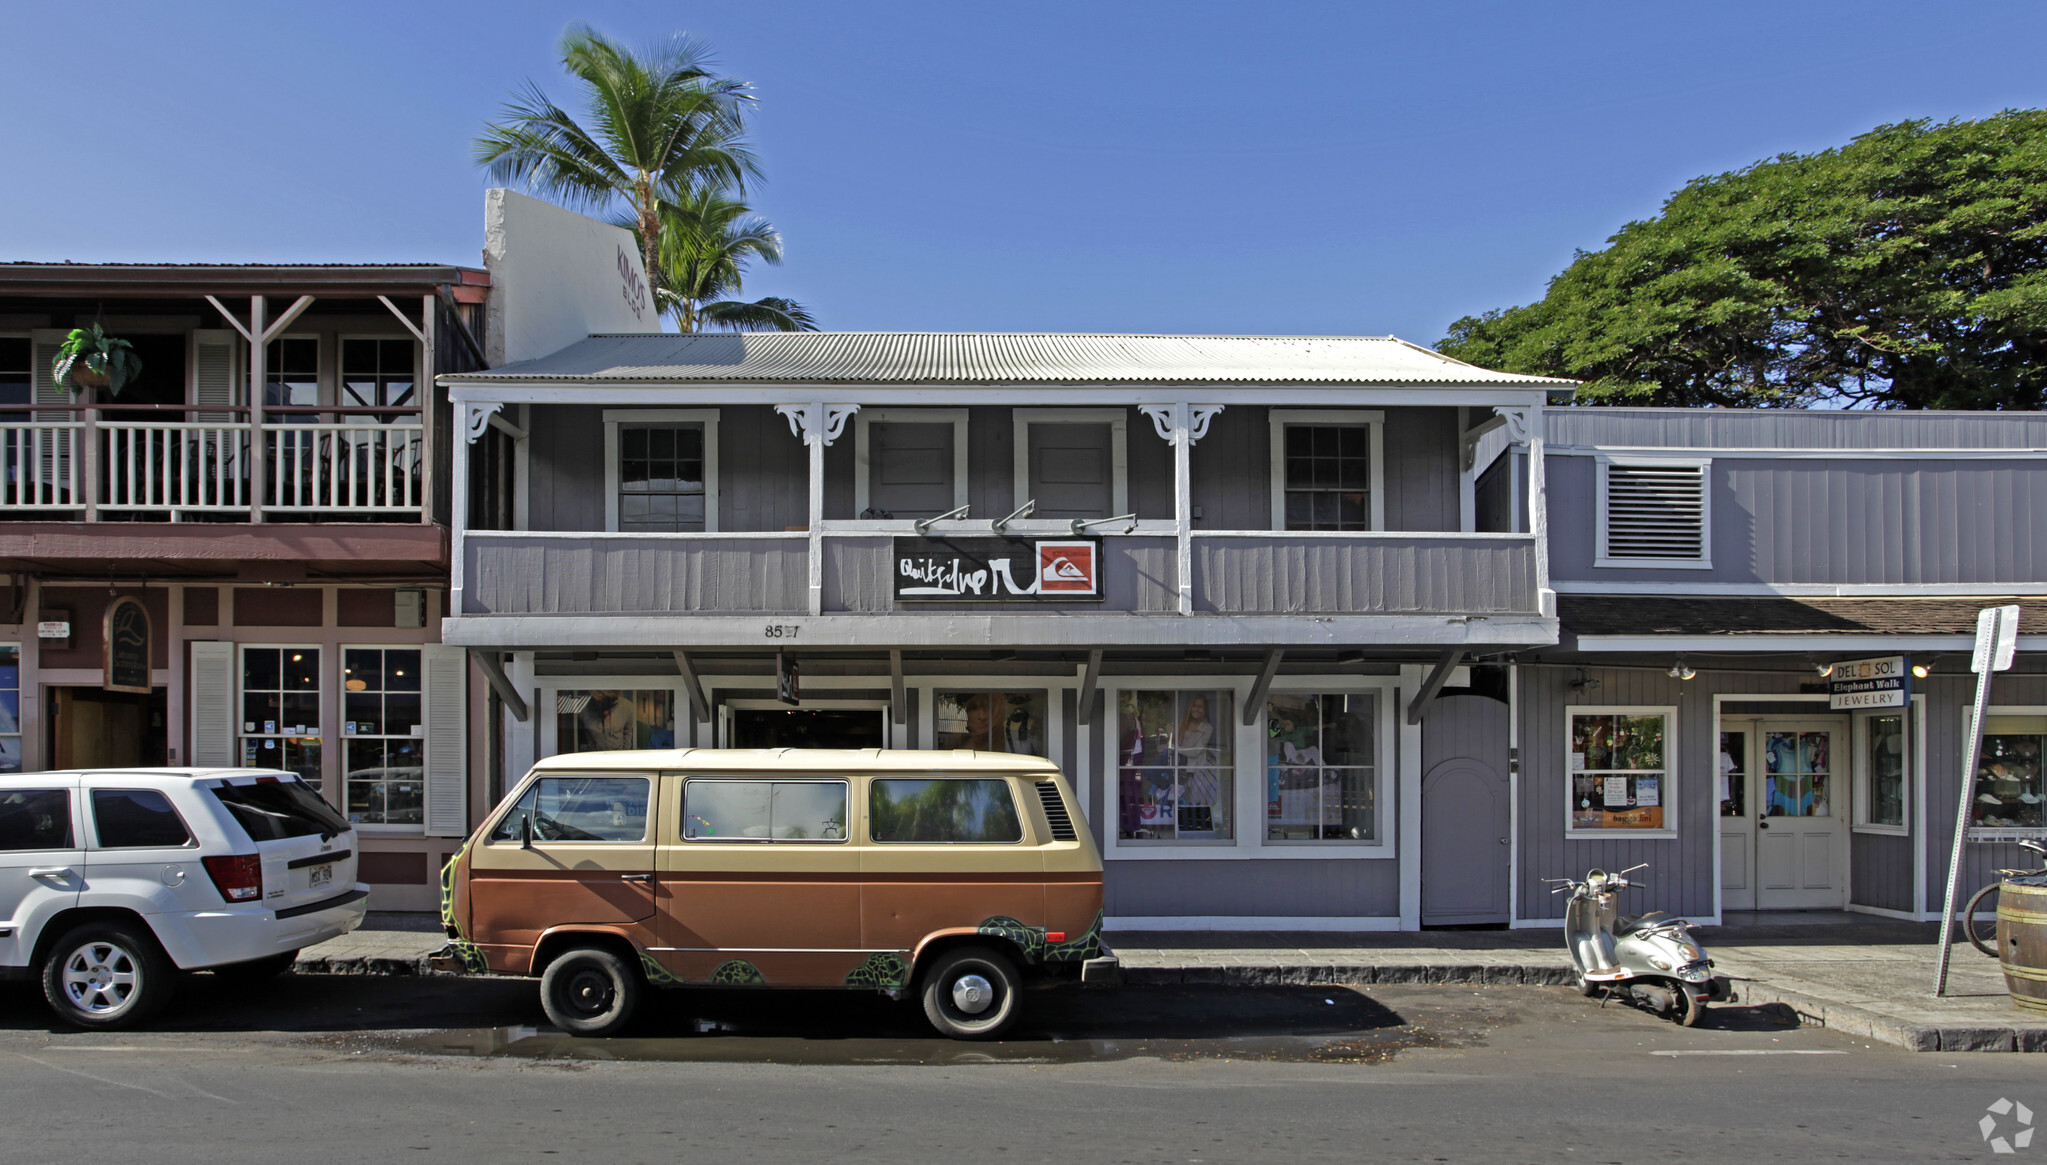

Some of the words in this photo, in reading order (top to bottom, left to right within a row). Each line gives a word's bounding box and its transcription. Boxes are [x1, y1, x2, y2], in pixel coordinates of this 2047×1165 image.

[617, 243, 646, 310] KIMO'S
[1837, 665, 1857, 678] DEL
[1874, 661, 1896, 675] SOL
[1834, 682, 1875, 692] Elephant
[1876, 679, 1900, 689] Walk
[1838, 693, 1894, 706] JEWELRY
